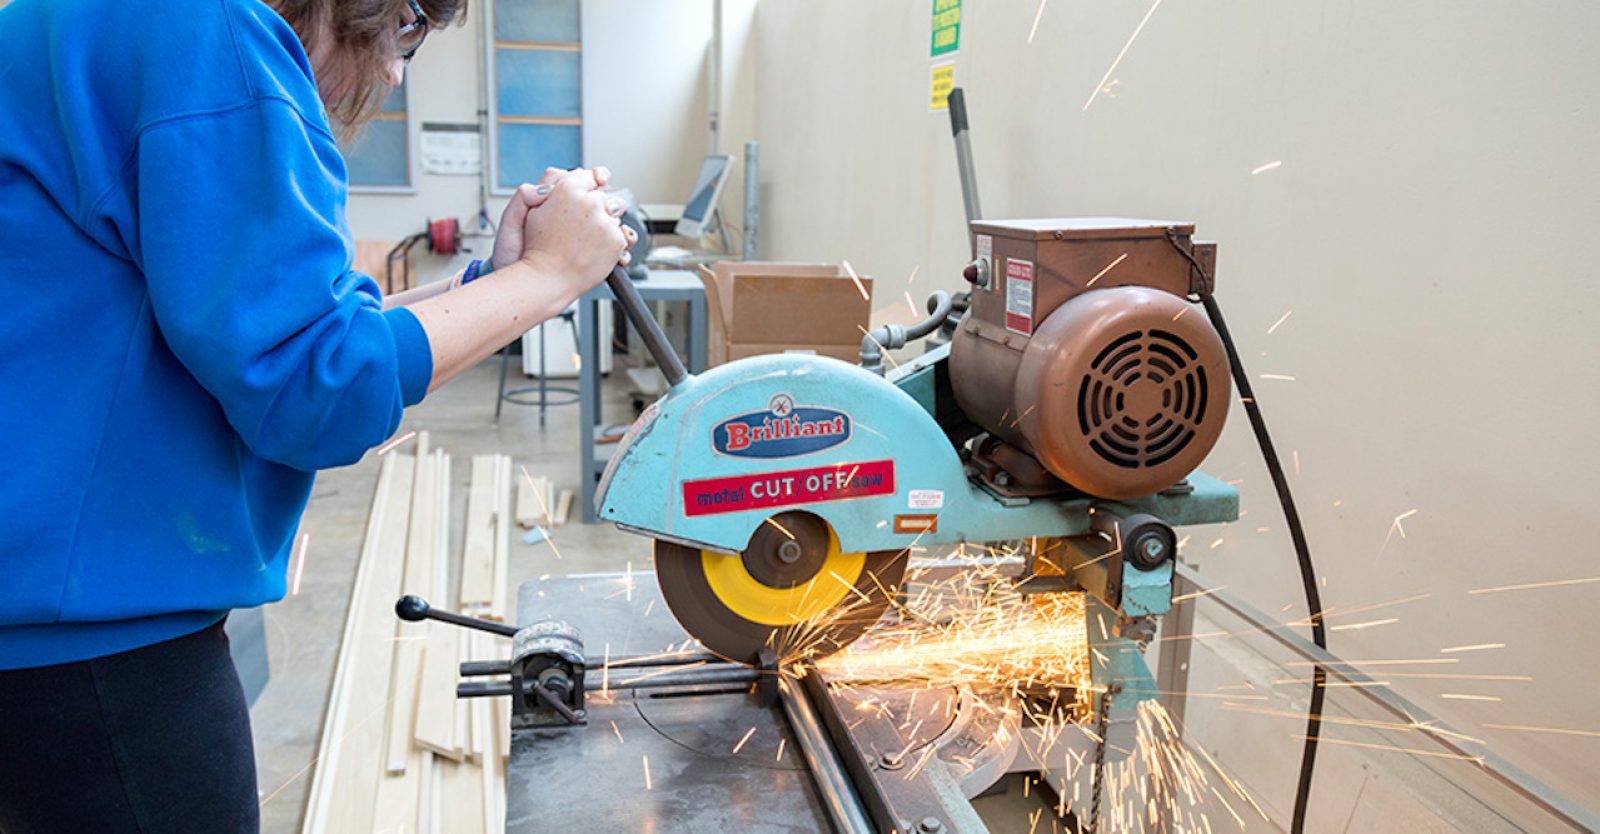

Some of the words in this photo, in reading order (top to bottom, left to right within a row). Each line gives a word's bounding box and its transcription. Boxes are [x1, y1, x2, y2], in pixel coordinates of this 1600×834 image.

[725, 414, 845, 451] Brilliant
[697, 486, 745, 506] metal
[852, 473, 883, 489] saw
